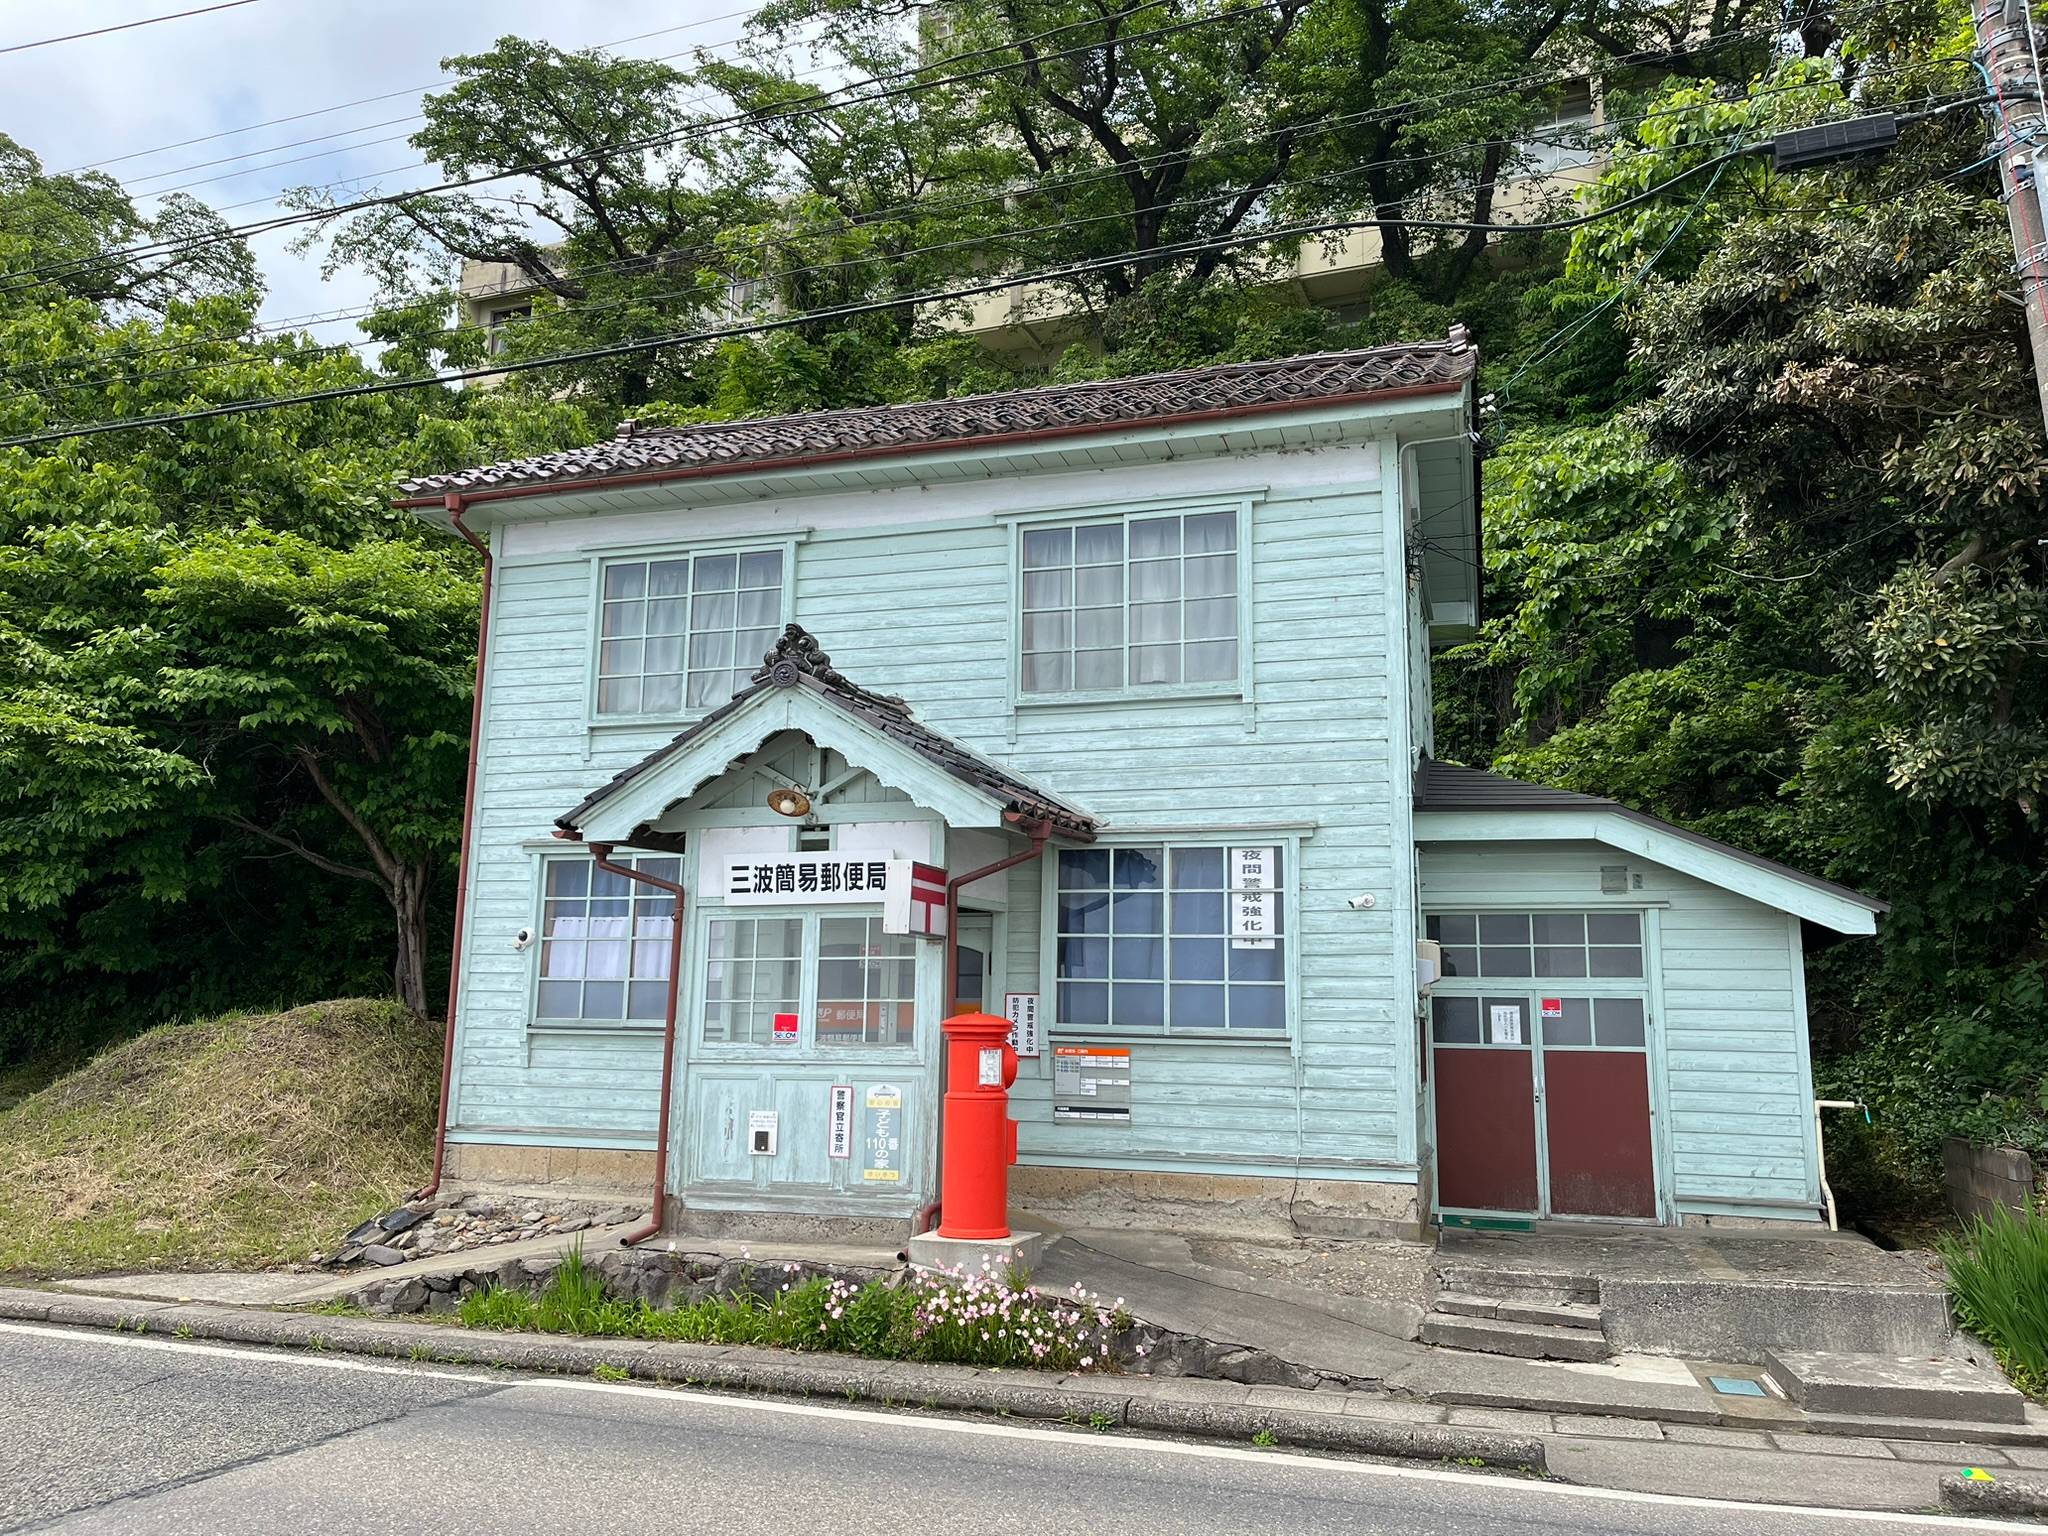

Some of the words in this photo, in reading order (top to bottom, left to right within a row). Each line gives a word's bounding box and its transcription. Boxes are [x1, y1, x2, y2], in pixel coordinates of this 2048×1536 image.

[730, 861, 887, 894] 三波簡易郵便局
[834, 1090, 845, 1153] 警察官立寄所
